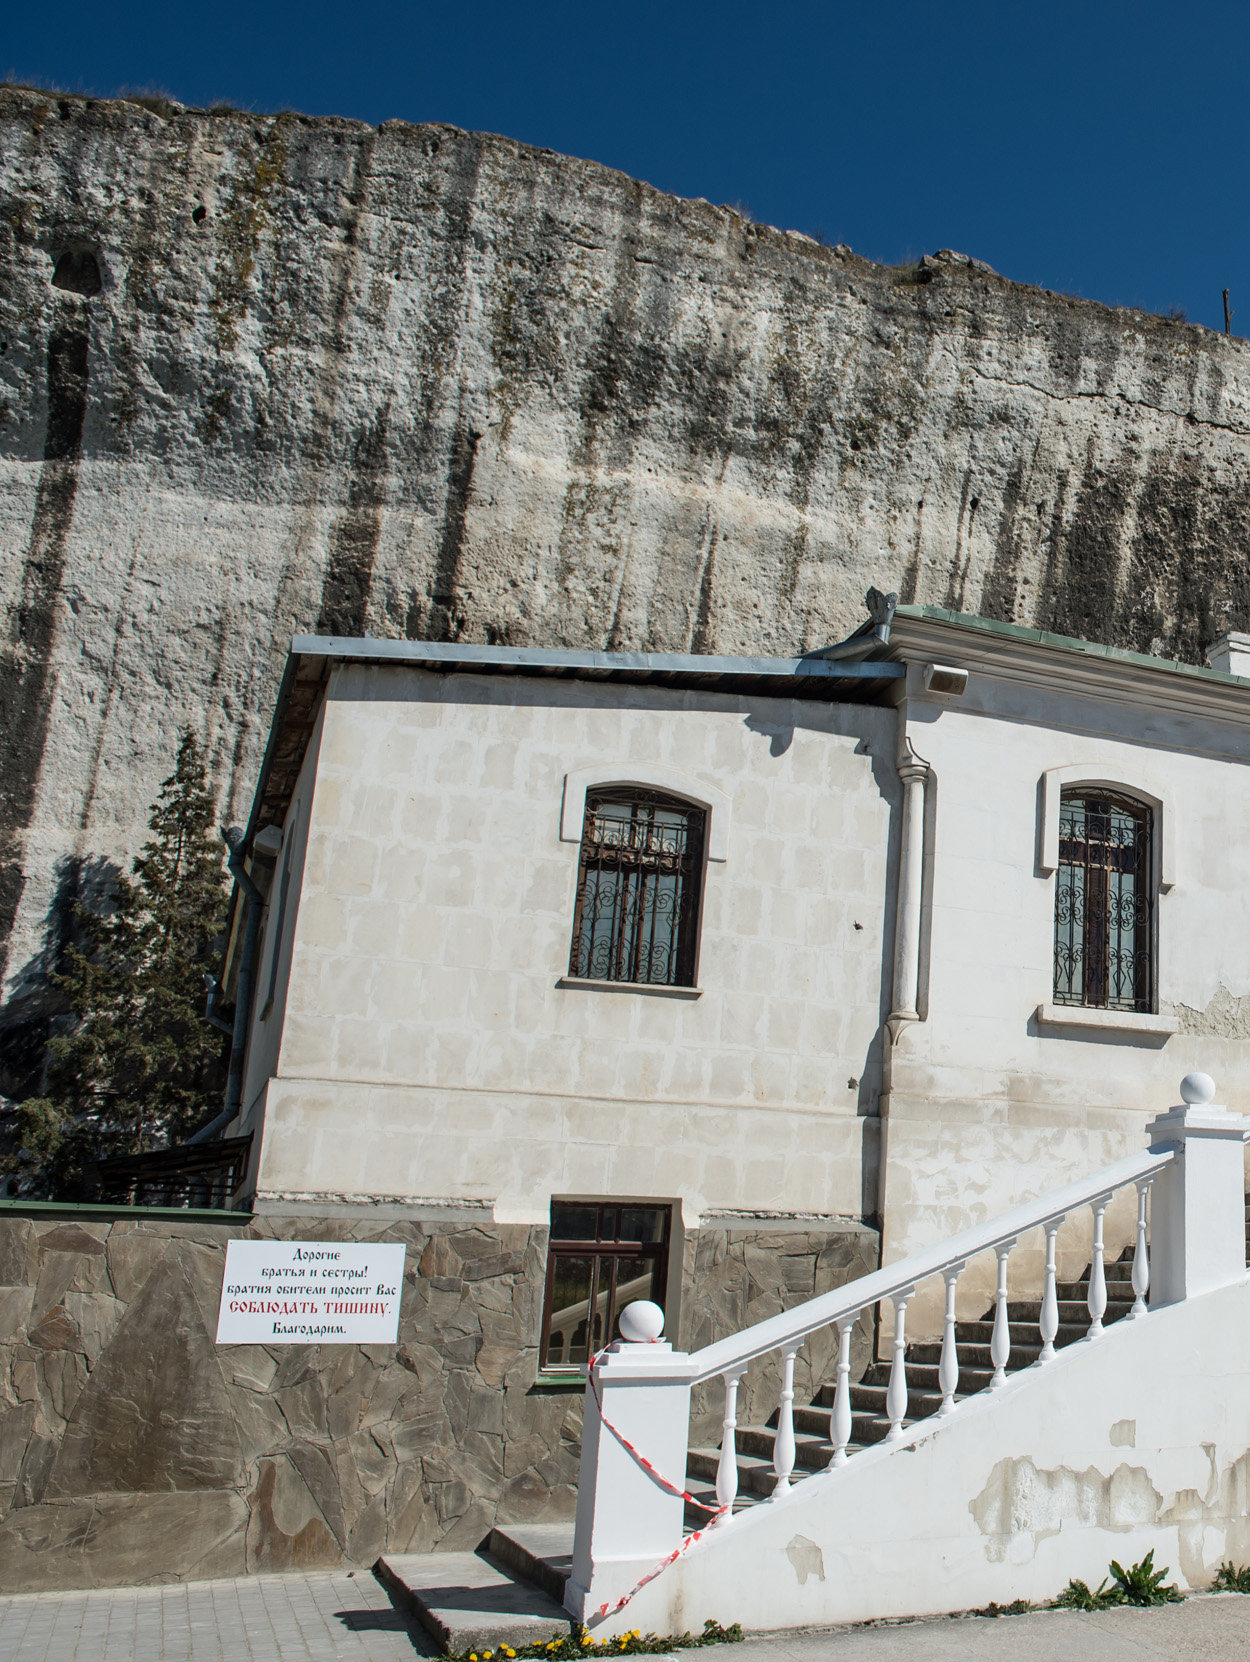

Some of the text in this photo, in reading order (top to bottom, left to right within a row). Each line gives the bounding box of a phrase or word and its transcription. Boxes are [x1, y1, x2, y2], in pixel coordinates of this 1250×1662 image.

[293, 1248, 341, 1262] Дорогие
[261, 1265, 368, 1280] братья и сестры!
[227, 1284, 396, 1297] братия обители просит Вас
[229, 1301, 392, 1317] СОБЛЮДАТЬ ТИШИНУ.
[272, 1322, 347, 1337] Благодарим.
